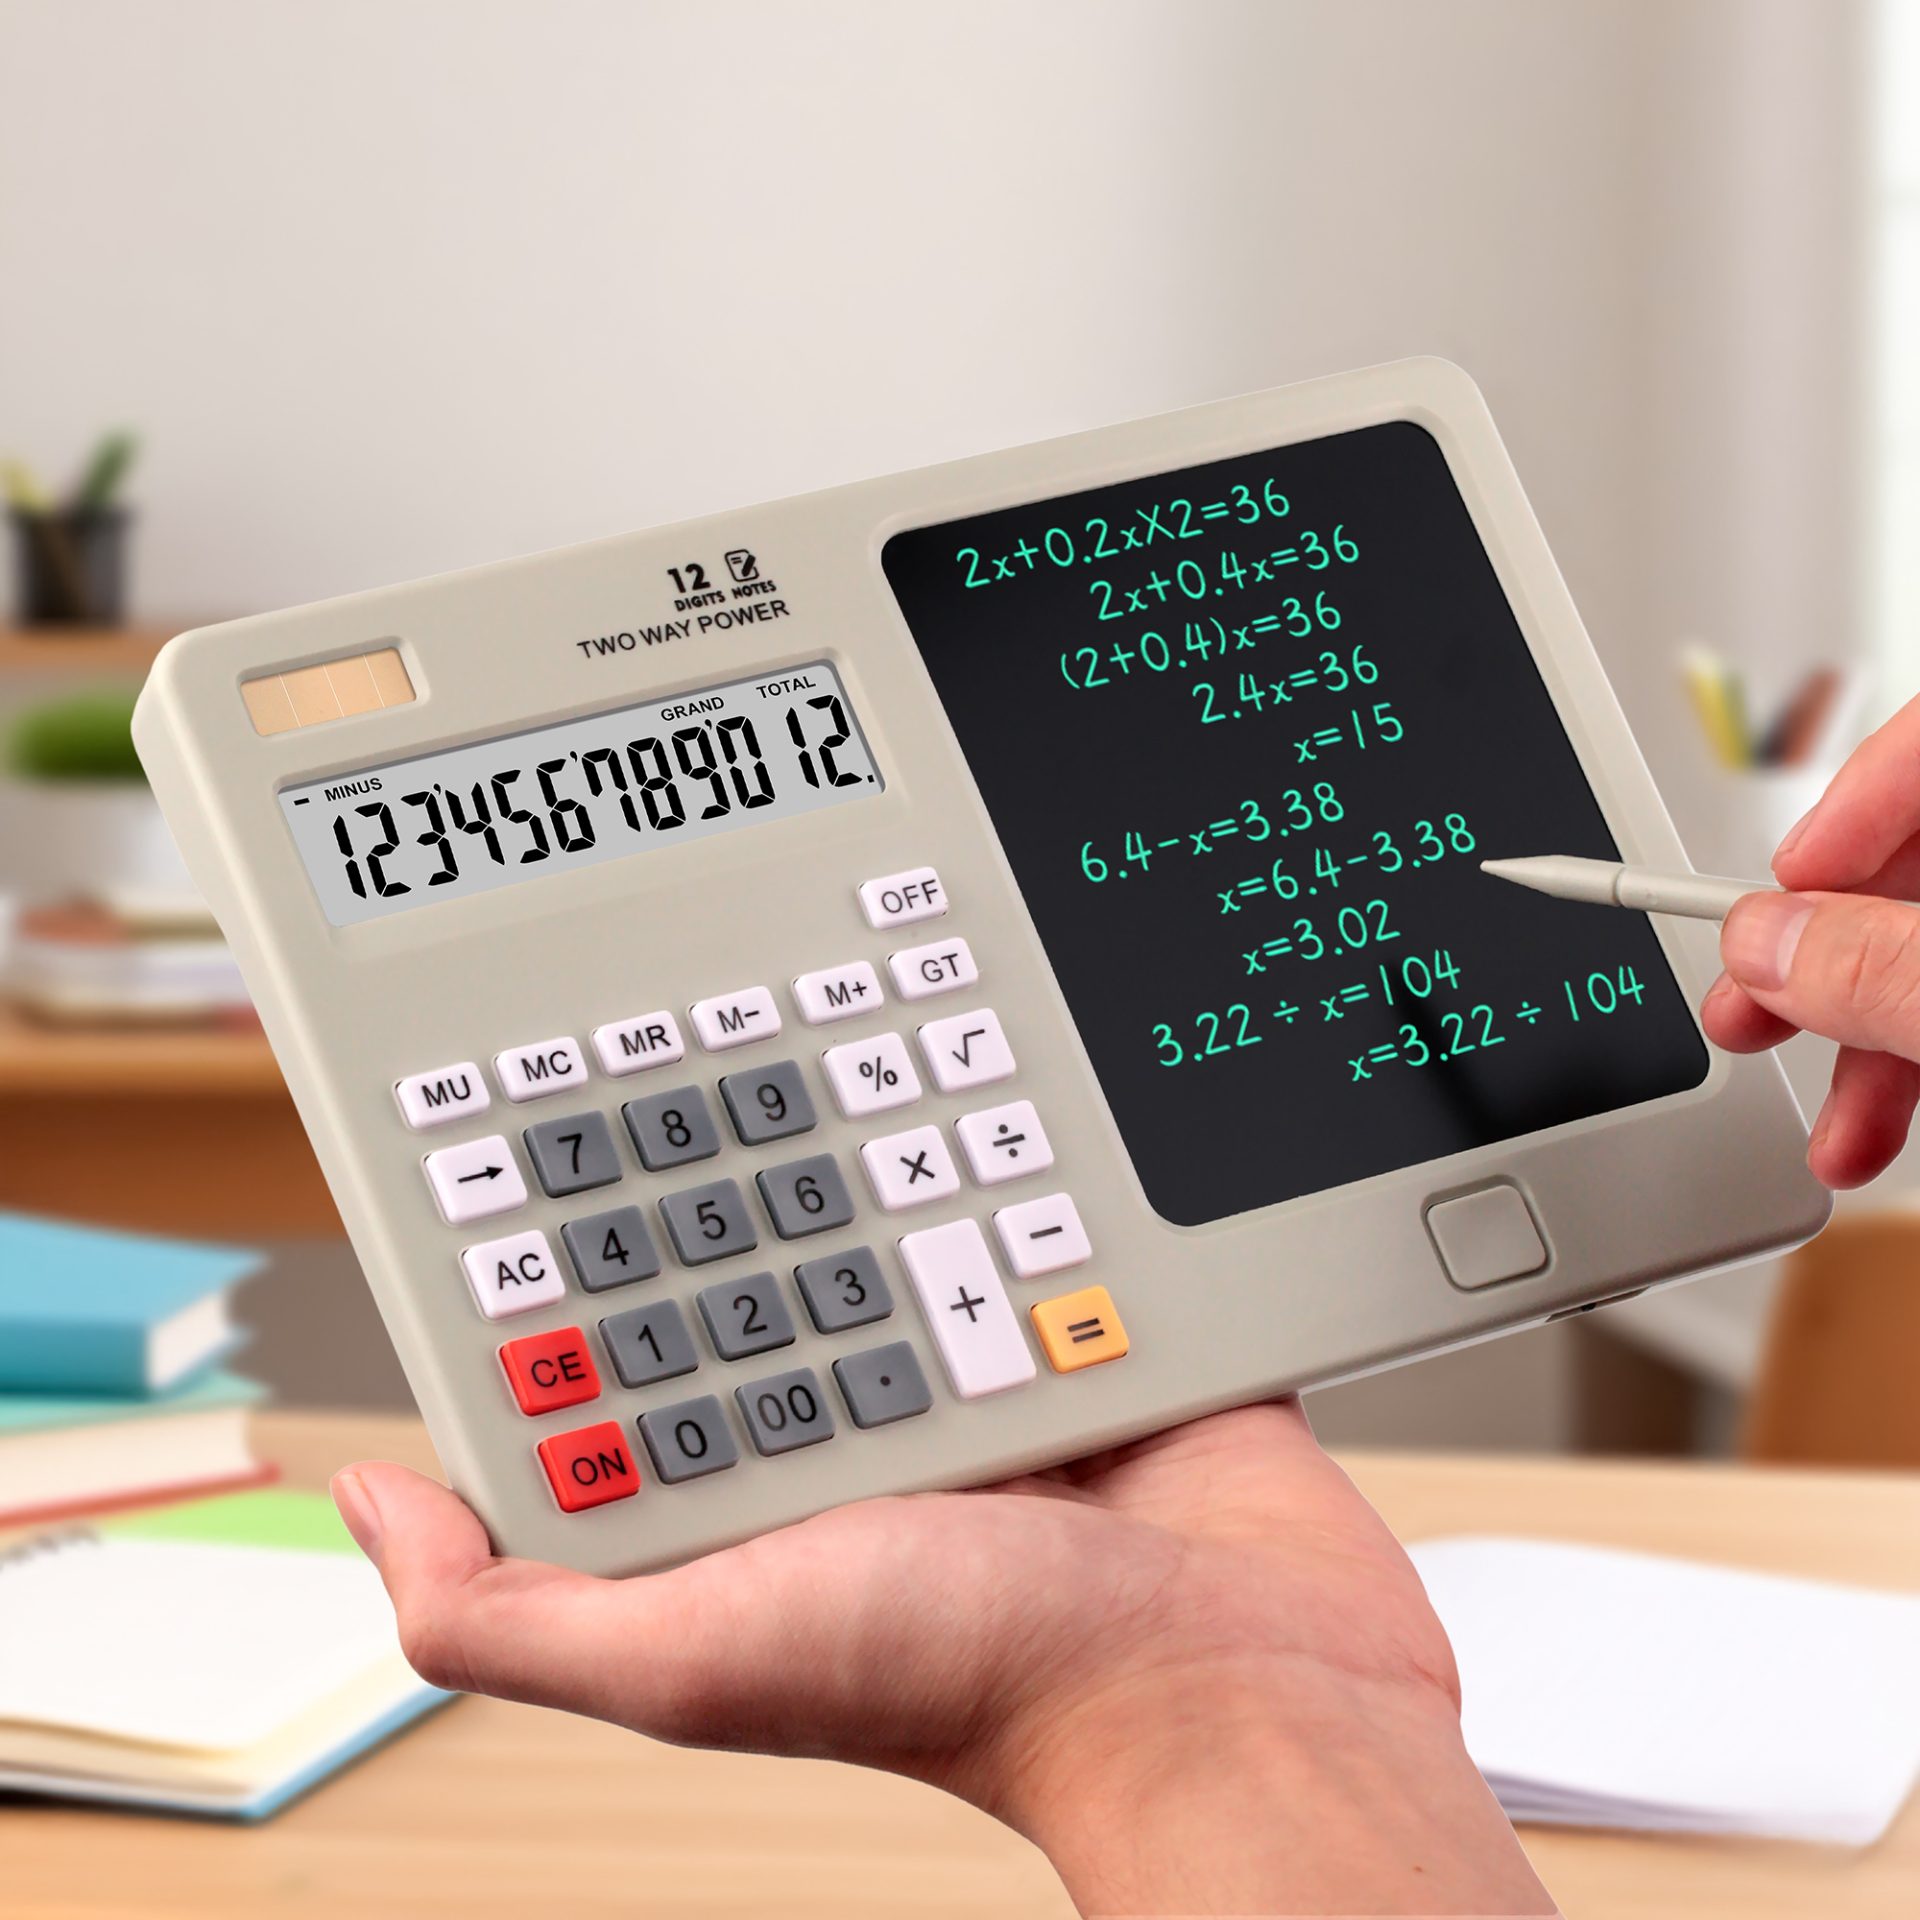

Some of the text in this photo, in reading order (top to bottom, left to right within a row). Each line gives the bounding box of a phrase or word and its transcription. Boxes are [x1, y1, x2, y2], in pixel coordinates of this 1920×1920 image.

[667, 563, 711, 594] 12
[1090, 525, 1359, 620] 2x+0.4x=36
[674, 580, 777, 612] DIGITS NOTES
[576, 599, 790, 659] TWO WAY POWER
[660, 675, 816, 722] GRAND TOTAL
[1192, 645, 1378, 723] 2.4x=36
[1294, 703, 1403, 763] x=15
[324, 777, 383, 802] MINUS
[882, 880, 937, 913] OFF
[1242, 899, 1400, 975] x=3.02
[922, 953, 958, 982] GT
[825, 982, 866, 1006] M+
[620, 1025, 671, 1055] MR
[1152, 1004, 1262, 1066] 3.22
[522, 1051, 571, 1081] MC
[422, 1075, 470, 1107] MU
[758, 1084, 786, 1120] 9
[662, 1110, 691, 1147] 8
[558, 1133, 582, 1174] 7
[796, 1177, 824, 1213] 6
[697, 1201, 726, 1240] 5
[603, 1228, 629, 1265] 4
[499, 1253, 545, 1289] AC
[838, 1269, 865, 1305] 3
[738, 1295, 767, 1335] 2
[639, 1325, 662, 1362] 1
[532, 1354, 586, 1387] CE
[758, 1385, 817, 1429] 00
[675, 1420, 707, 1458] 0
[572, 1448, 627, 1485] ON
